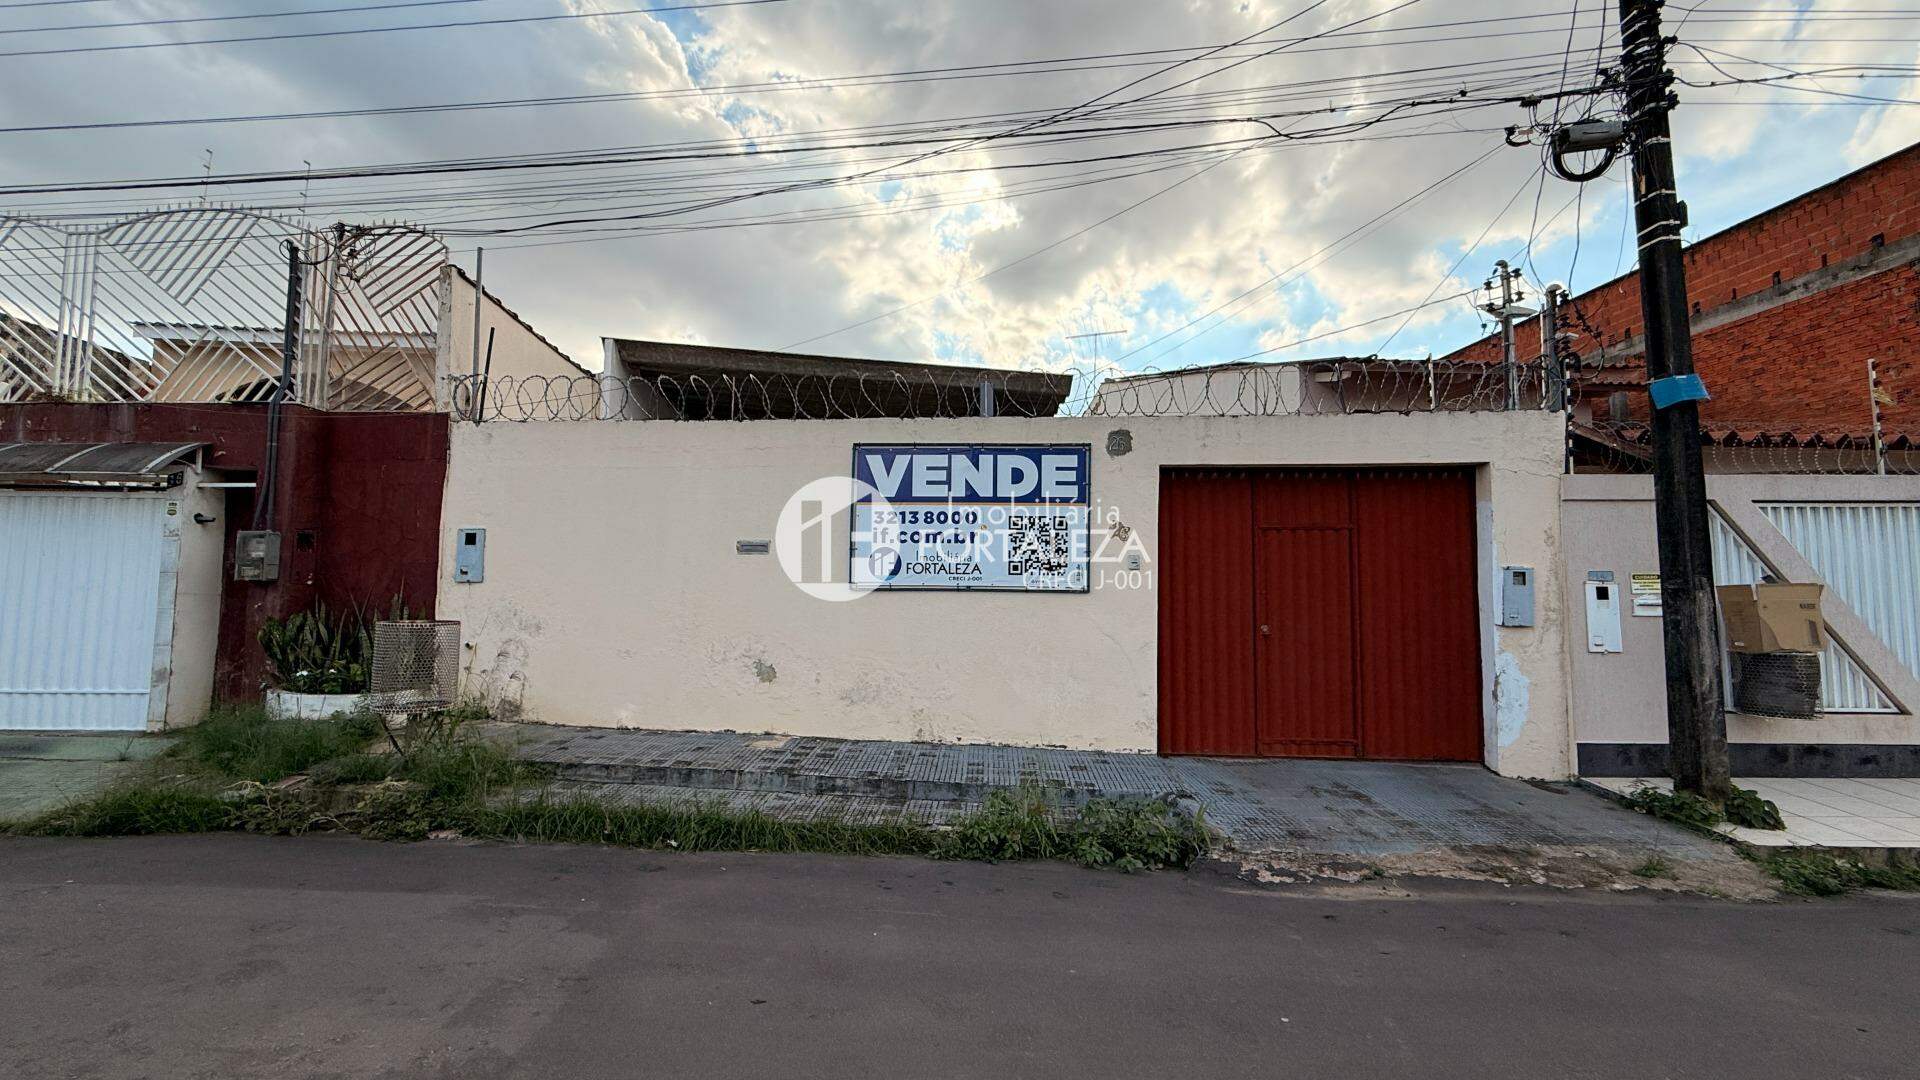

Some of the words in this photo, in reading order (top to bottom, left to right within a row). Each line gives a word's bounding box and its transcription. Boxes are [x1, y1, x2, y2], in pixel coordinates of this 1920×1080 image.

[865, 454, 1079, 498] VENDE
[873, 510, 919, 525] 3213
[923, 510, 978, 525] 8000
[872, 526, 979, 544] if.com.br
[905, 562, 983, 575] FORTALEZA
